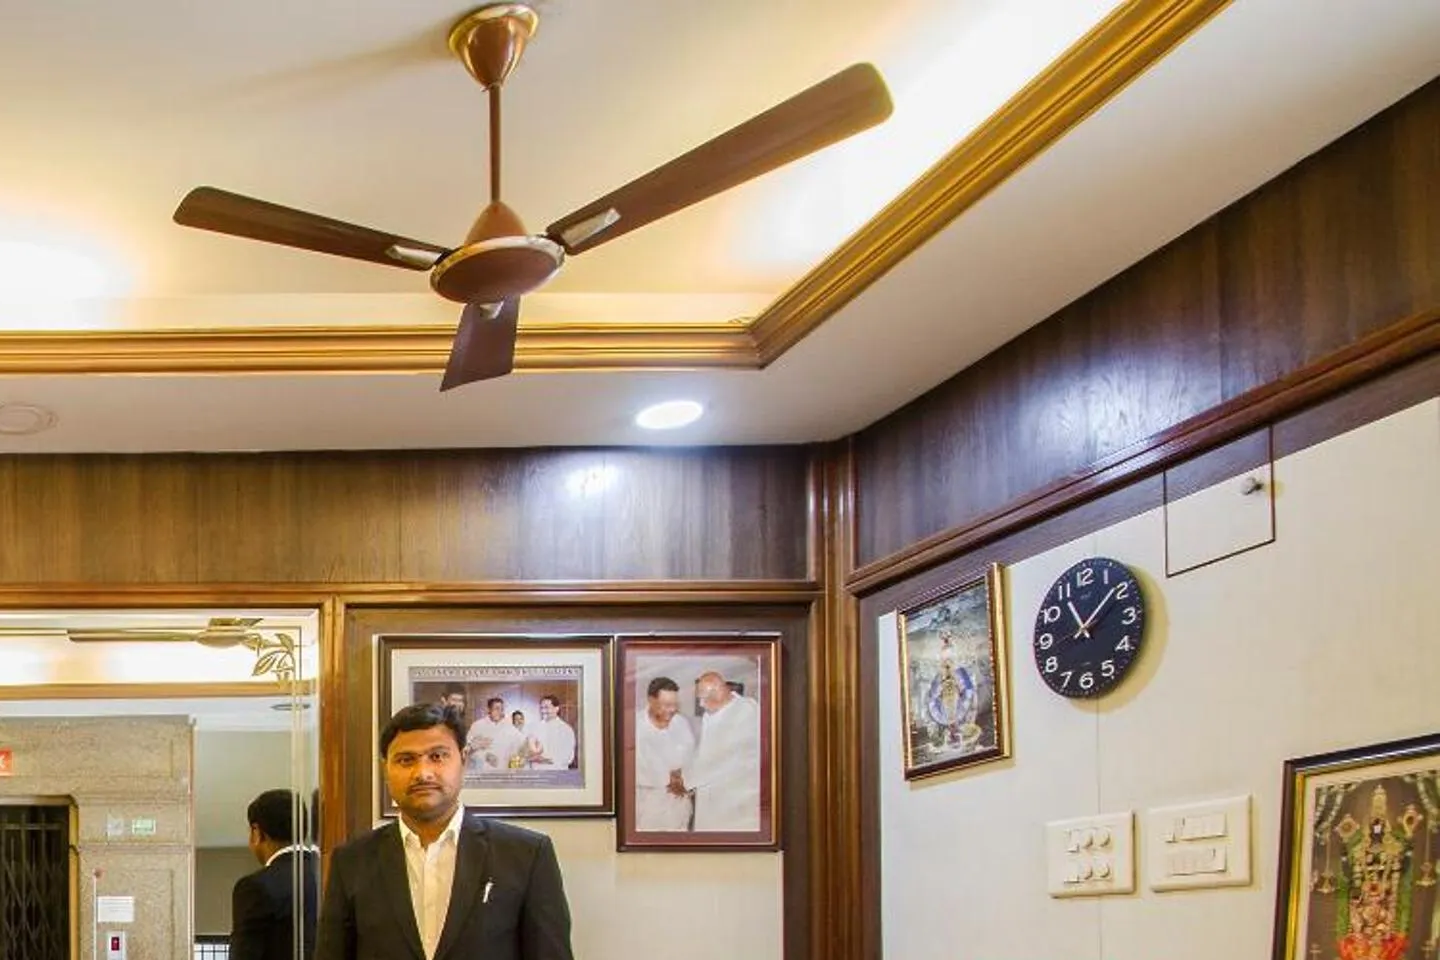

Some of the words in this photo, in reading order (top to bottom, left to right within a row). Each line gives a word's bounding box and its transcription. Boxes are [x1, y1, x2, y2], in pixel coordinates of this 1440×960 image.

[1077, 568, 1094, 587] 12
[1103, 569, 1109, 585] 1
[1059, 583, 1071, 600] 11
[1116, 582, 1129, 600] 2
[1042, 606, 1061, 624] 10
[1122, 607, 1137, 625] 3
[1040, 633, 1054, 650] 9
[1115, 635, 1131, 652] 4
[1045, 656, 1059, 673] 8
[1101, 660, 1115, 677] 5
[1061, 671, 1073, 688] 7
[1079, 672, 1094, 689] 6
